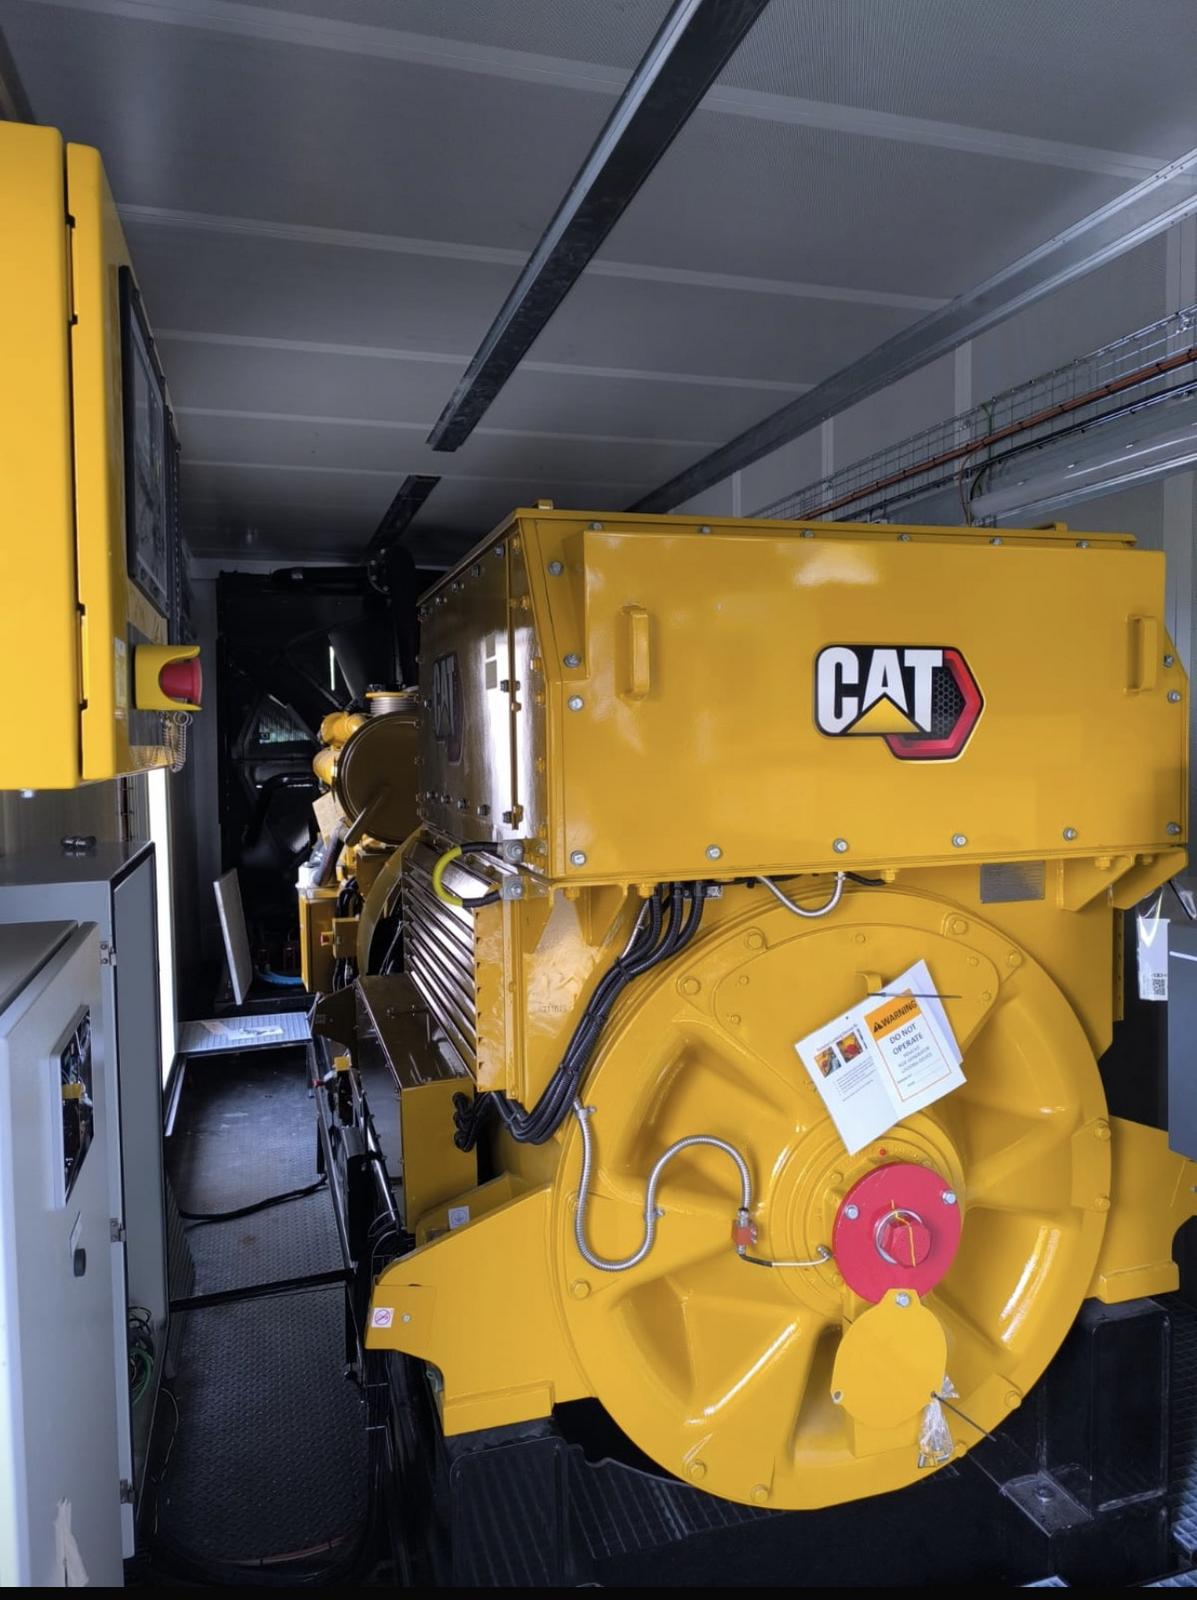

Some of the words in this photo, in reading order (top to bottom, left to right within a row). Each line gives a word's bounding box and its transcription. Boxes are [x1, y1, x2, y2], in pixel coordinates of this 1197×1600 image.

[433, 655, 455, 736] CAT
[817, 646, 944, 735] CAT
[880, 1000, 918, 1028] WARNING
[889, 1033, 901, 1045] DO
[902, 1023, 917, 1038] NOT
[892, 1033, 923, 1055] OPERATE
